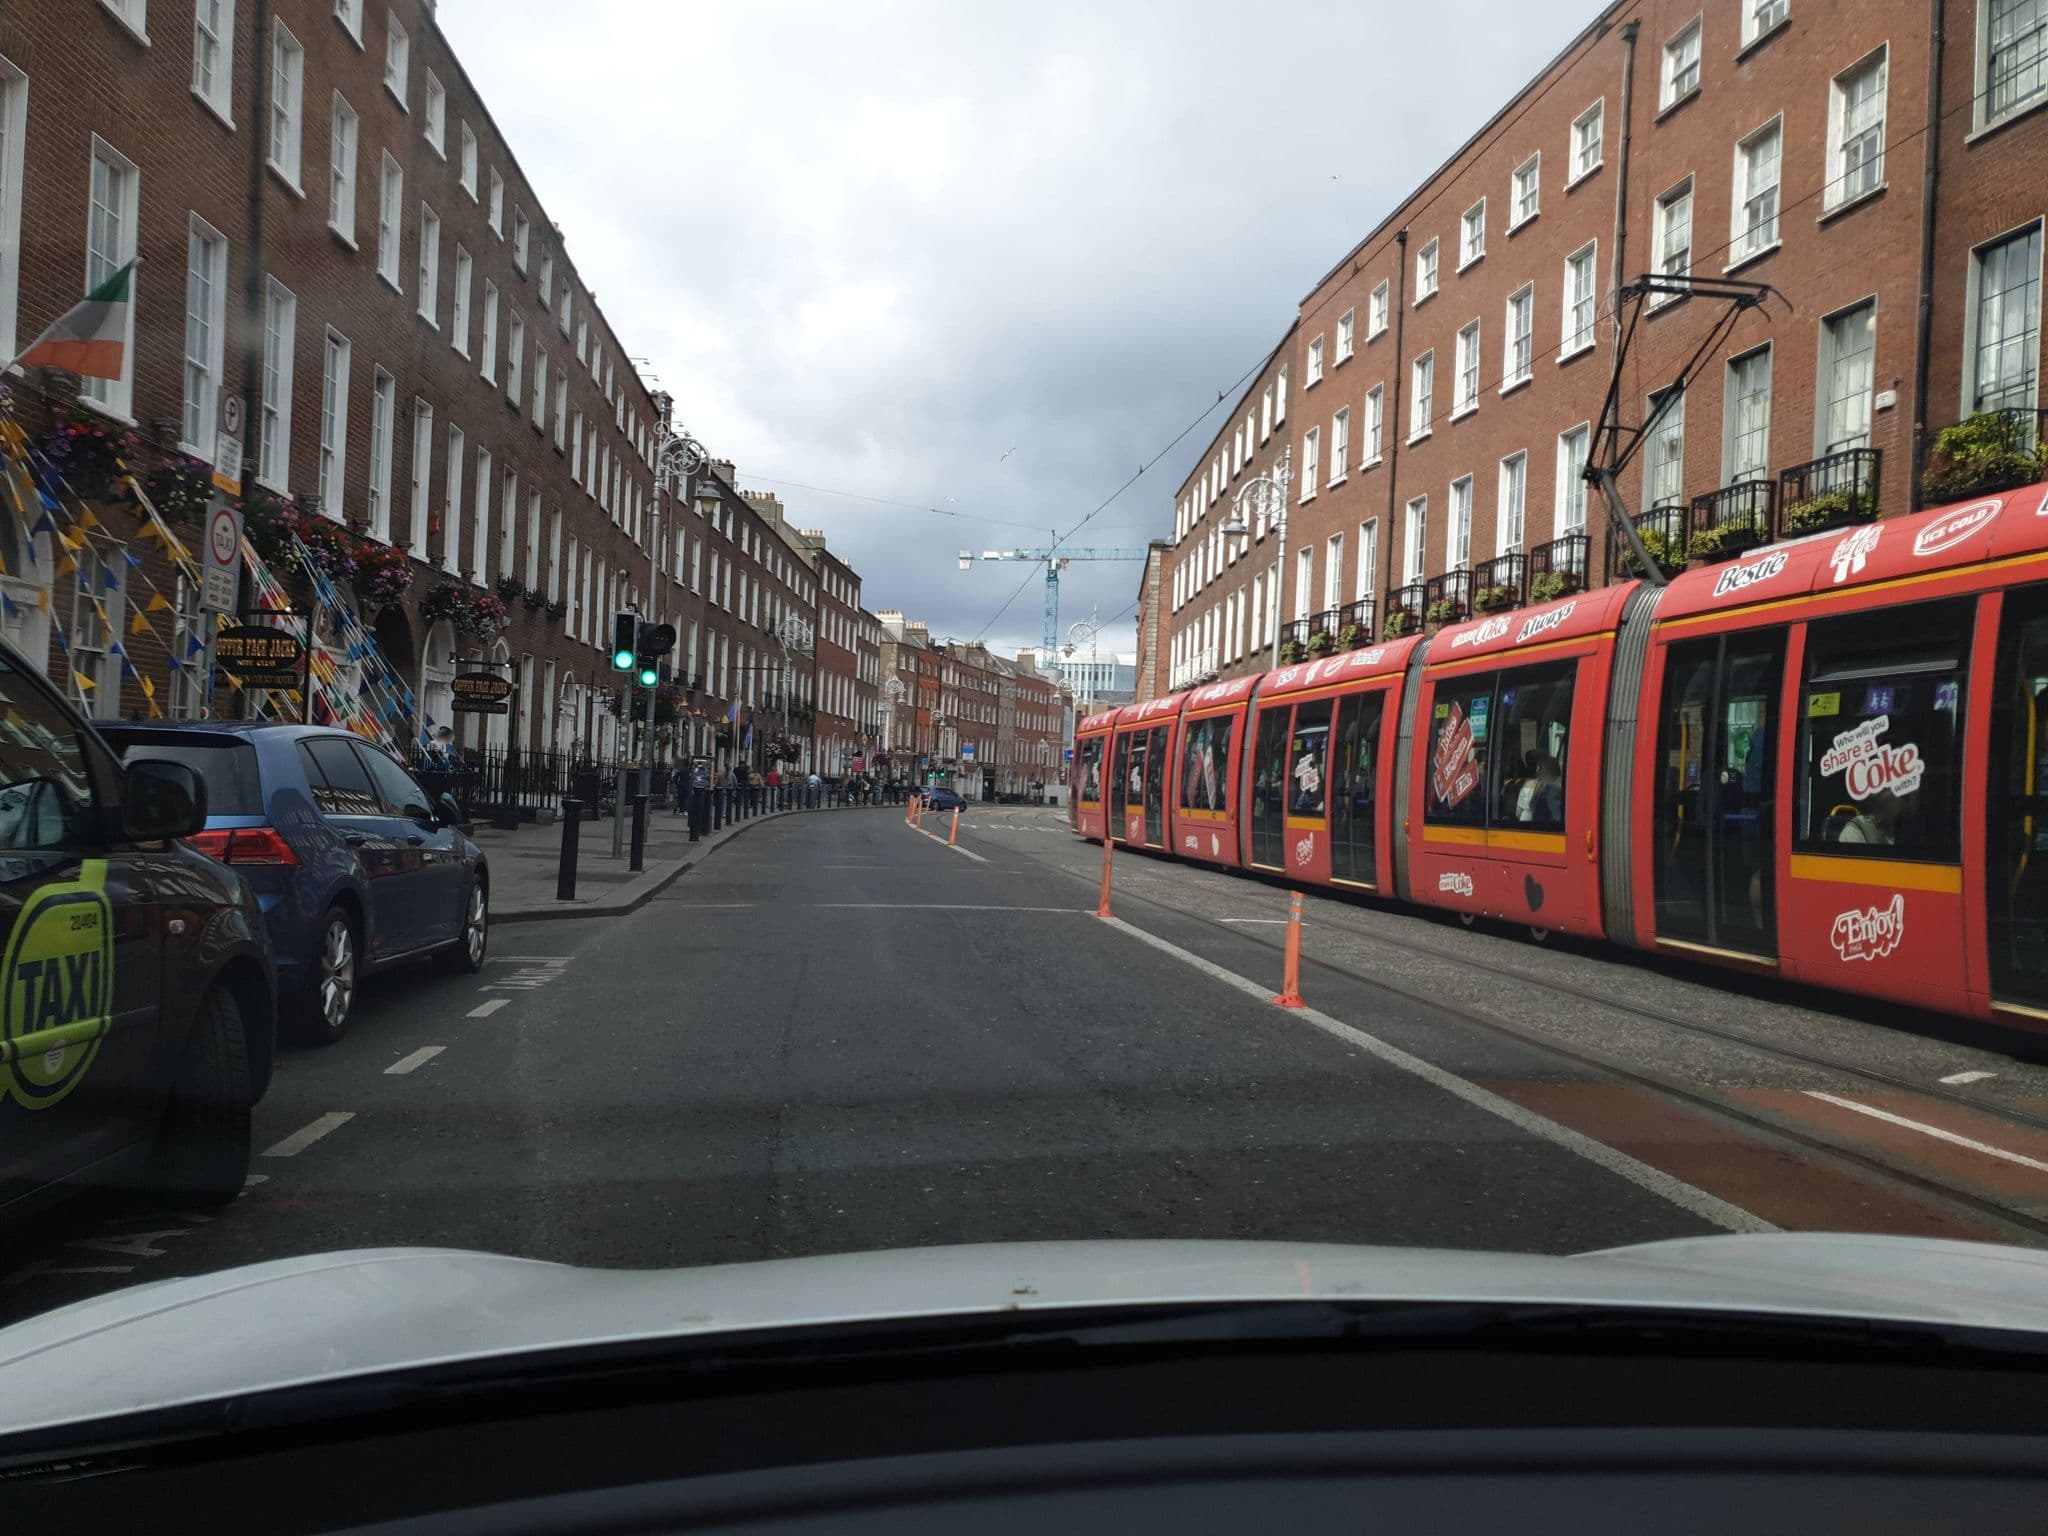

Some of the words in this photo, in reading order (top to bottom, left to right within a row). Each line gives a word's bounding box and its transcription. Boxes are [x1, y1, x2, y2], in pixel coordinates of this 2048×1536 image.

[1921, 528, 1945, 545] ICE
[1948, 509, 1988, 533] COLD
[1715, 553, 1787, 595] Bestie
[1517, 604, 1574, 642] Always
[270, 639, 296, 657] JACKS
[1836, 735, 1854, 748] Who
[1855, 726, 1870, 740] will
[1870, 720, 1886, 734] you
[1823, 744, 1861, 772] share
[1864, 739, 1873, 752] a
[1848, 747, 1915, 796] Coke
[1894, 776, 1918, 793] with?
[1837, 897, 1903, 944] Enjoy!
[18, 950, 100, 1034] TAXI
